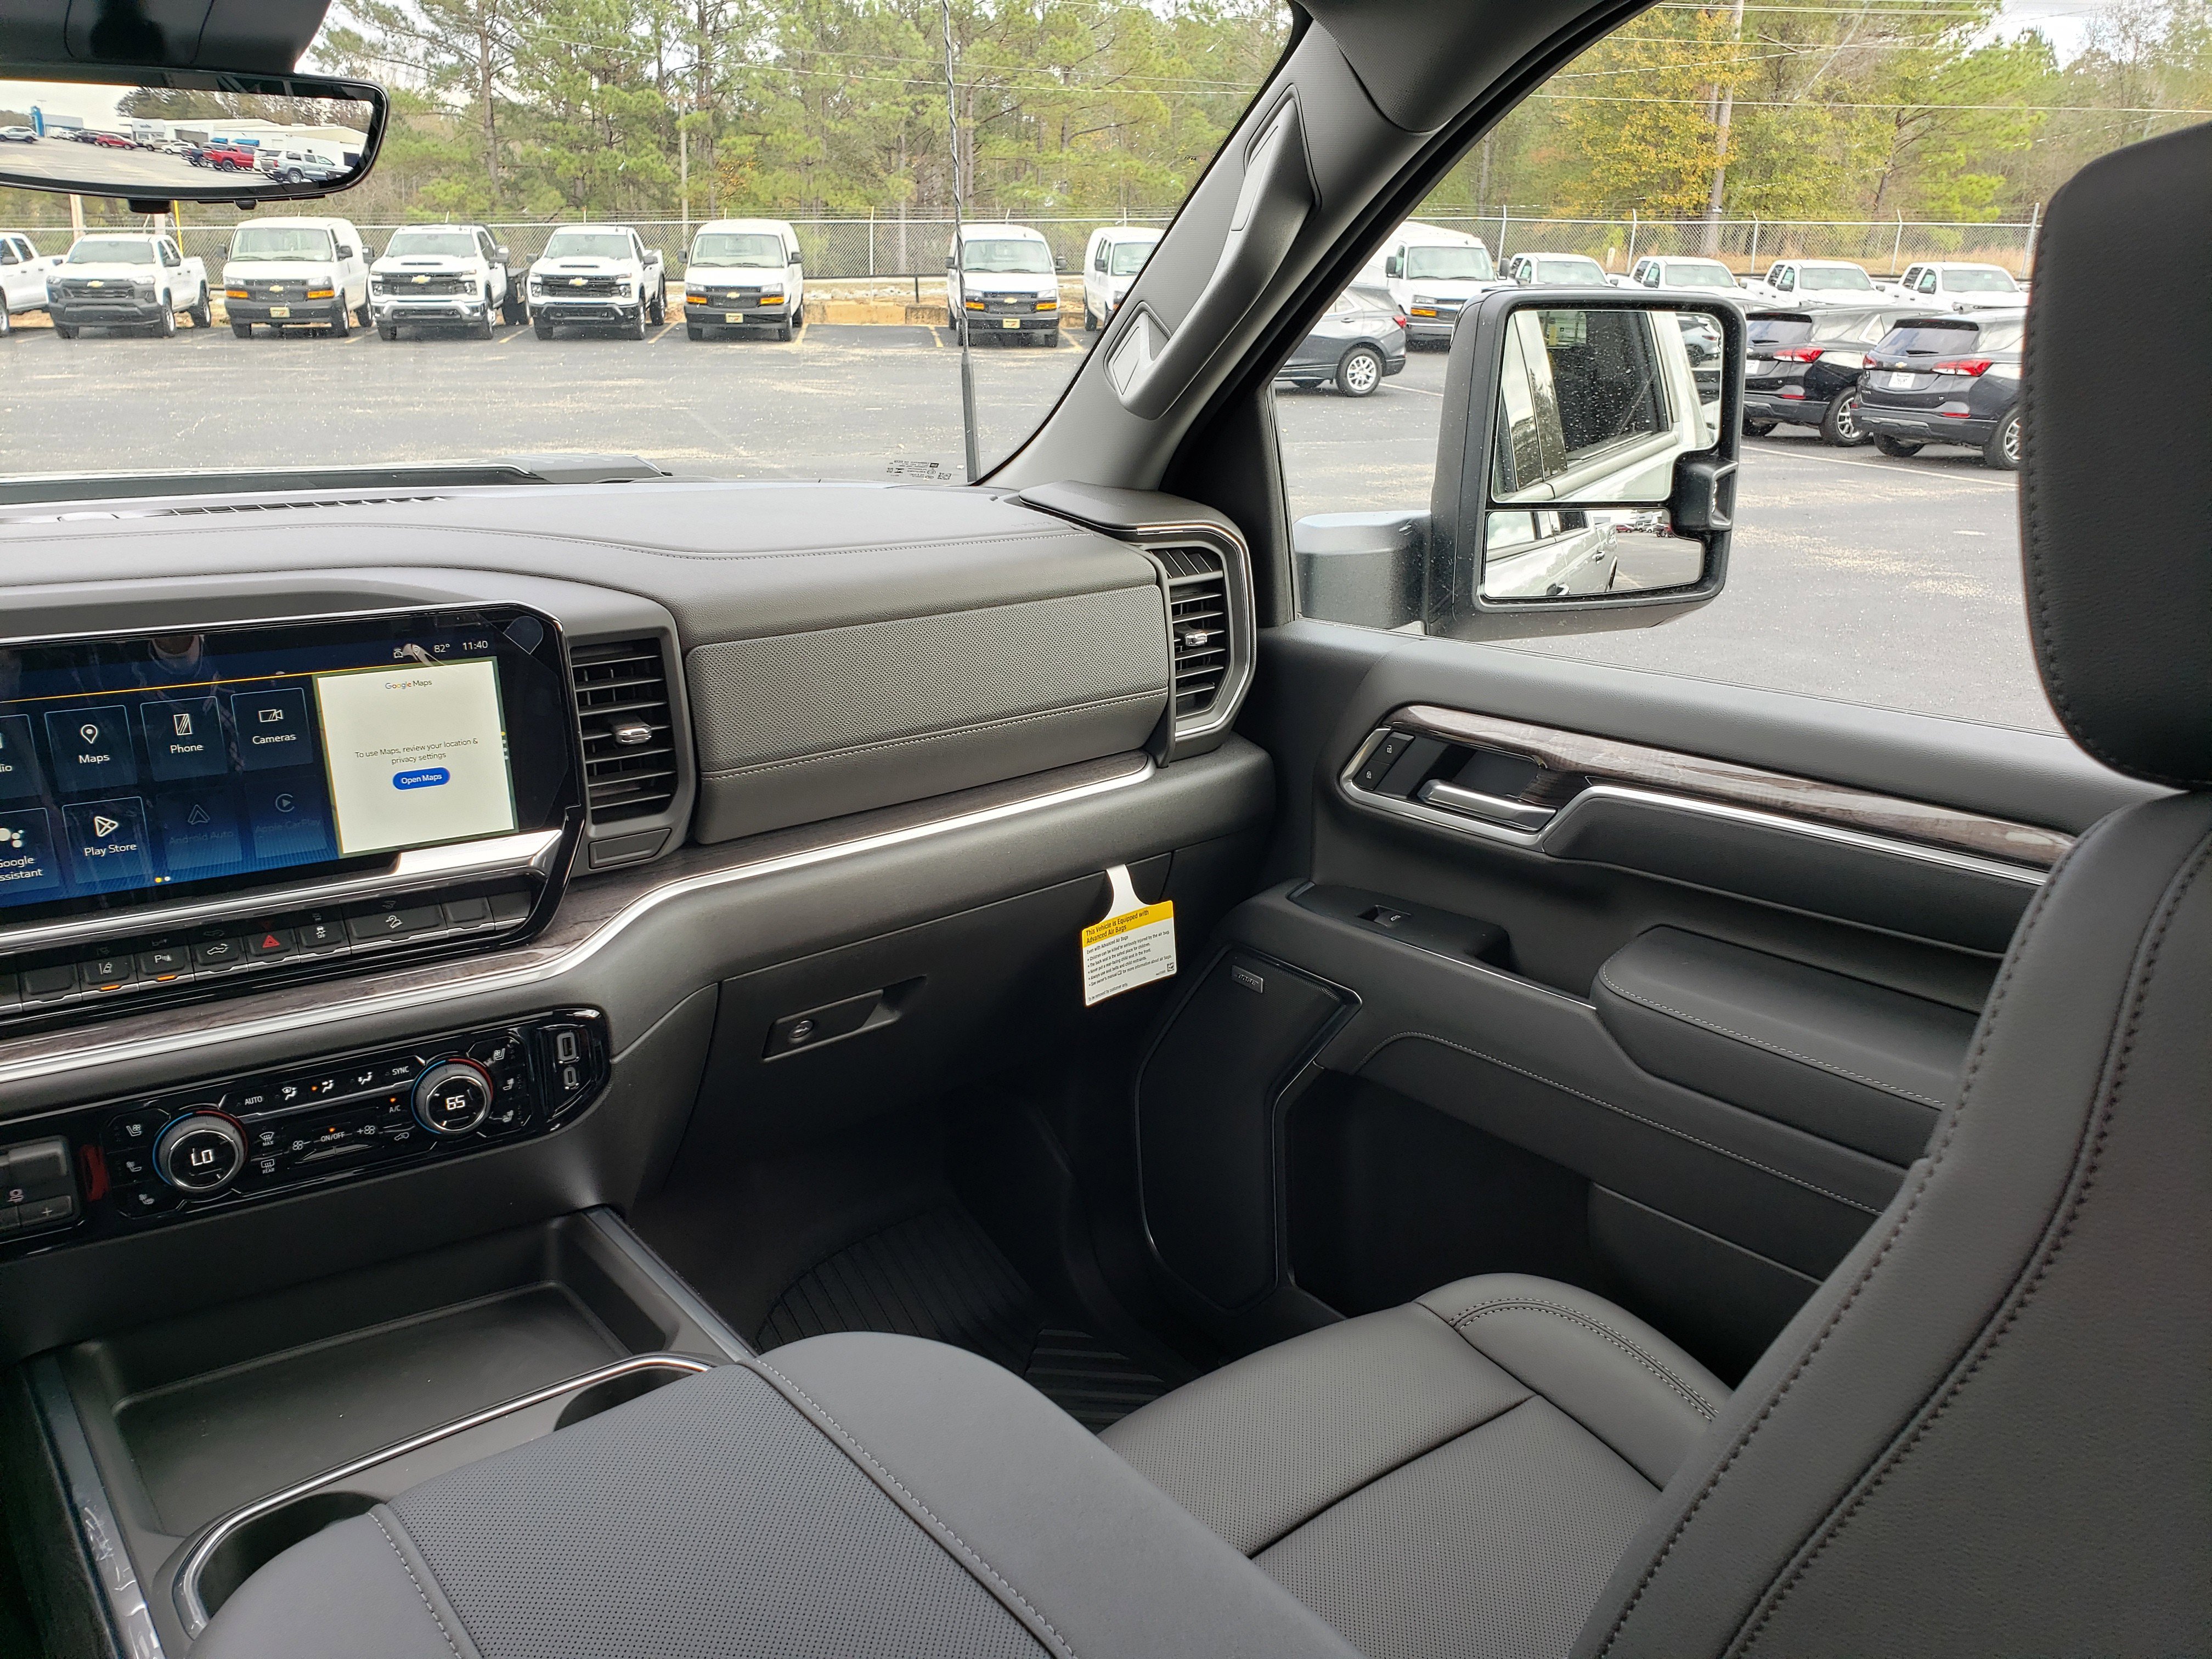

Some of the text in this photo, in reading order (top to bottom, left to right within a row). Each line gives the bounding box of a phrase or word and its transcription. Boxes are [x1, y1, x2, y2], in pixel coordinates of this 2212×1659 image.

[462, 640, 488, 651] 11:40
[385, 679, 432, 690] Google Maps
[252, 732, 296, 745] Cameras
[170, 743, 204, 753] Phone
[380, 747, 401, 756] Maps,
[403, 744, 425, 752] review
[427, 743, 442, 752] your
[444, 739, 471, 748] location
[79, 753, 110, 764] Maps
[392, 752, 446, 765] privacy settings
[401, 772, 442, 785] Open Maps
[170, 831, 234, 845] Android Auto
[84, 842, 137, 857] Play Store
[0, 868, 43, 881] ssistant
[1096, 923, 1111, 932] Vehicle
[1118, 913, 1138, 924] Equipped
[1087, 931, 1107, 944] Advanced
[1237, 973, 1258, 985] BOSE
[392, 1066, 409, 1076] SYNC
[245, 1095, 263, 1105] AUTO
[445, 1095, 466, 1110] 65
[320, 1131, 345, 1142] ON/OFF
